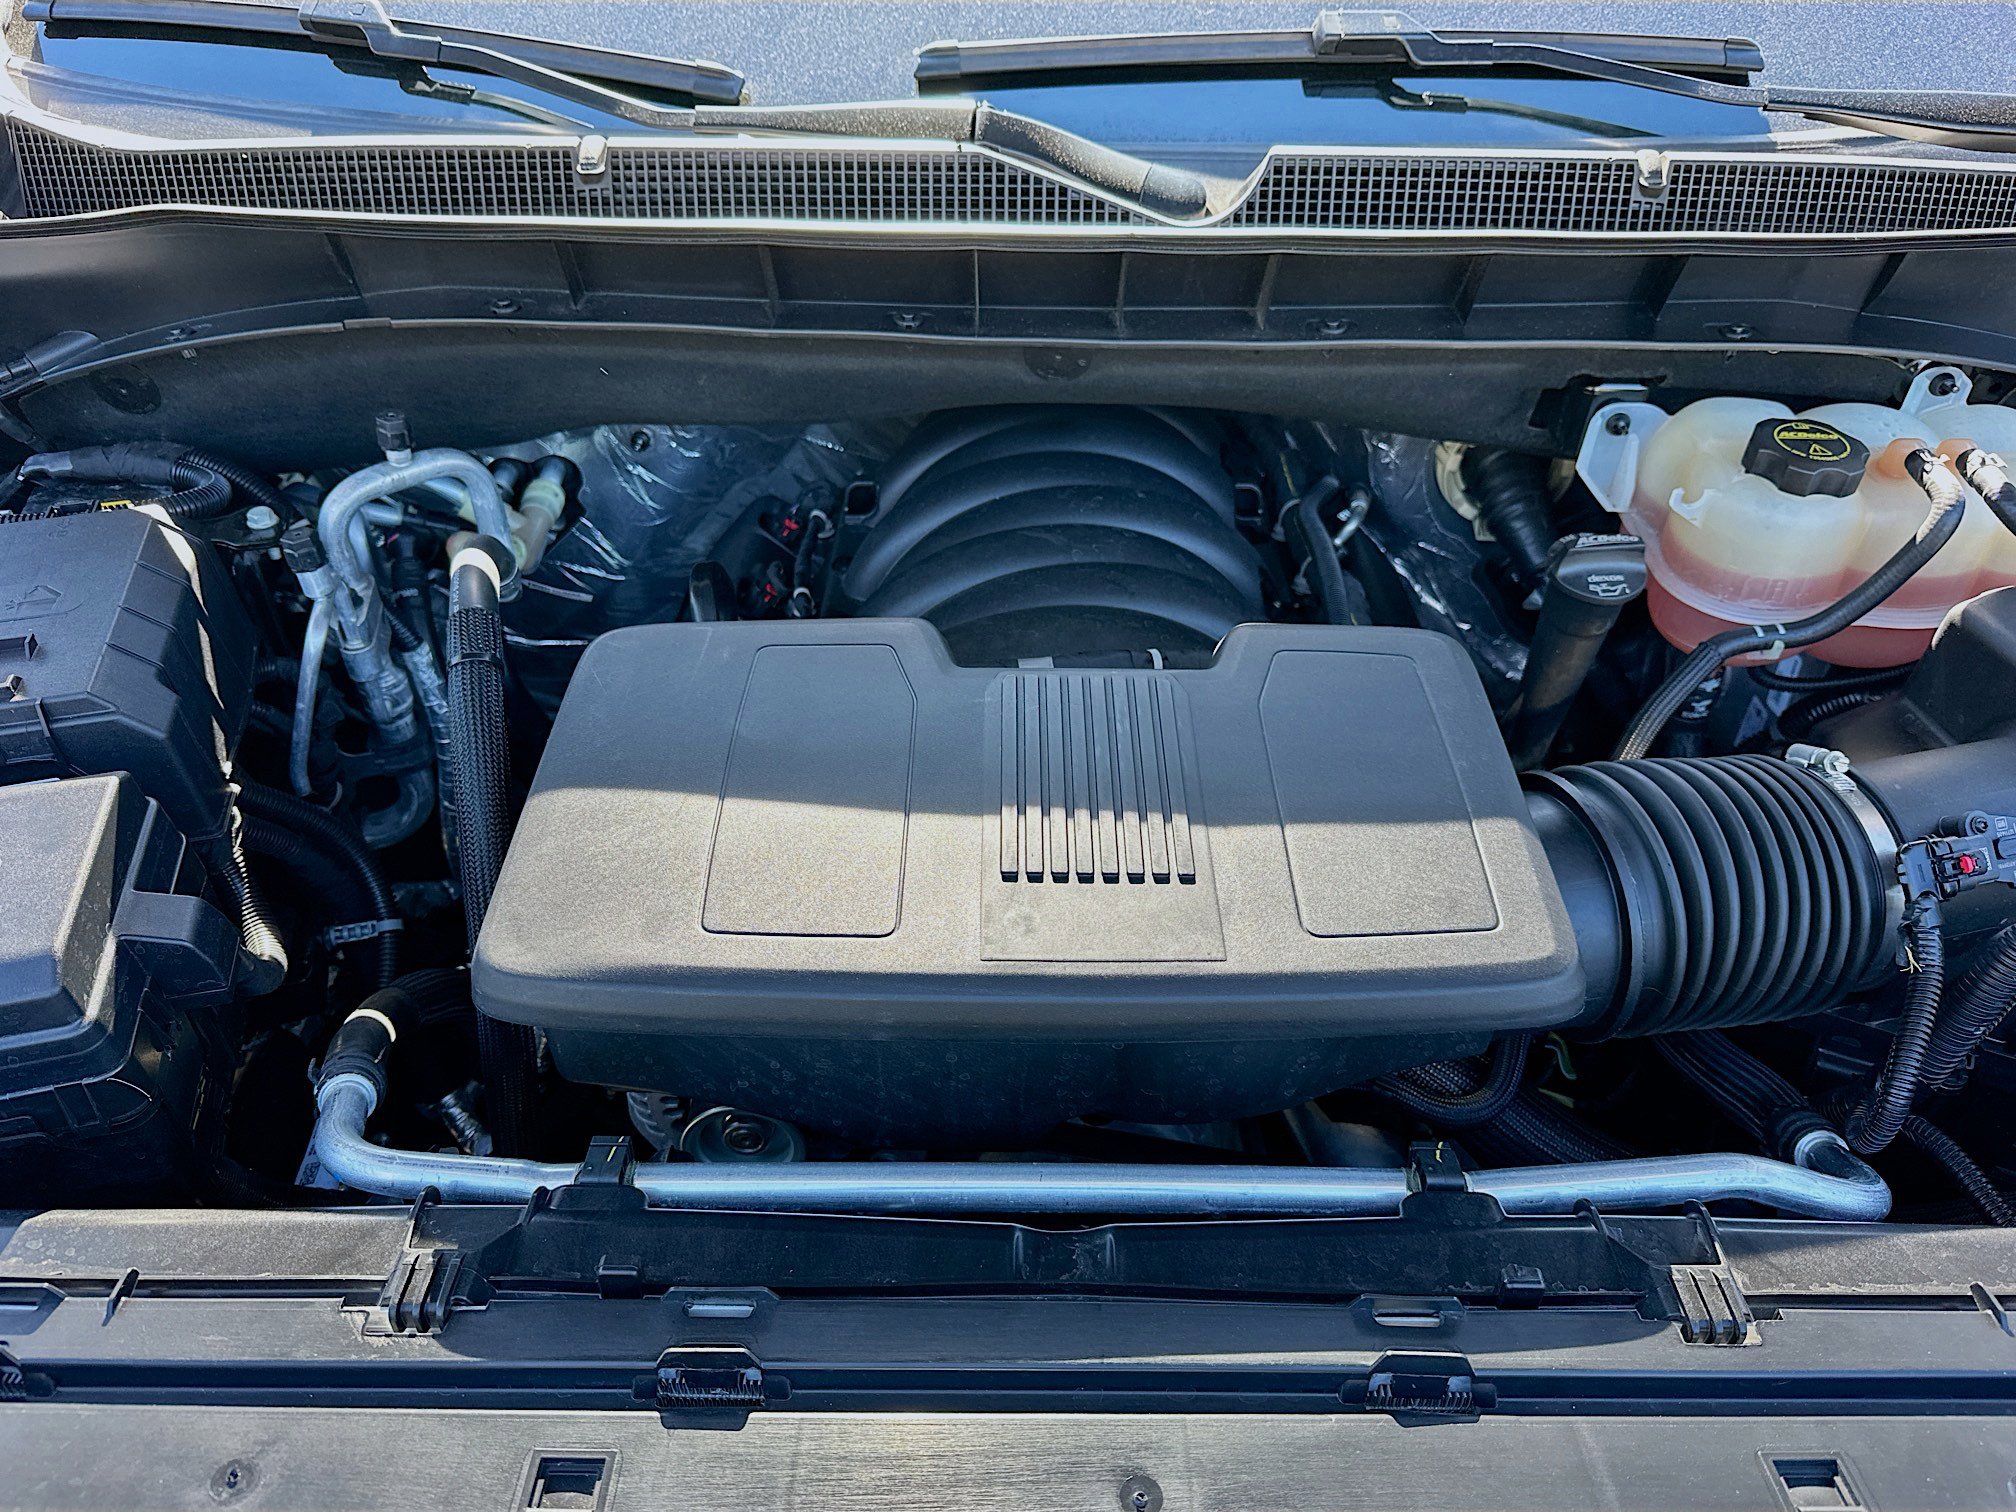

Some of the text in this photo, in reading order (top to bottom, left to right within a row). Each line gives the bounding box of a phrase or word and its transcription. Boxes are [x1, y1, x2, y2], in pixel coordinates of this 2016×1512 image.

[1778, 431, 1838, 439] ACDelco
[1577, 534, 1639, 545] ACDelco
[1587, 574, 1624, 583] dexos
